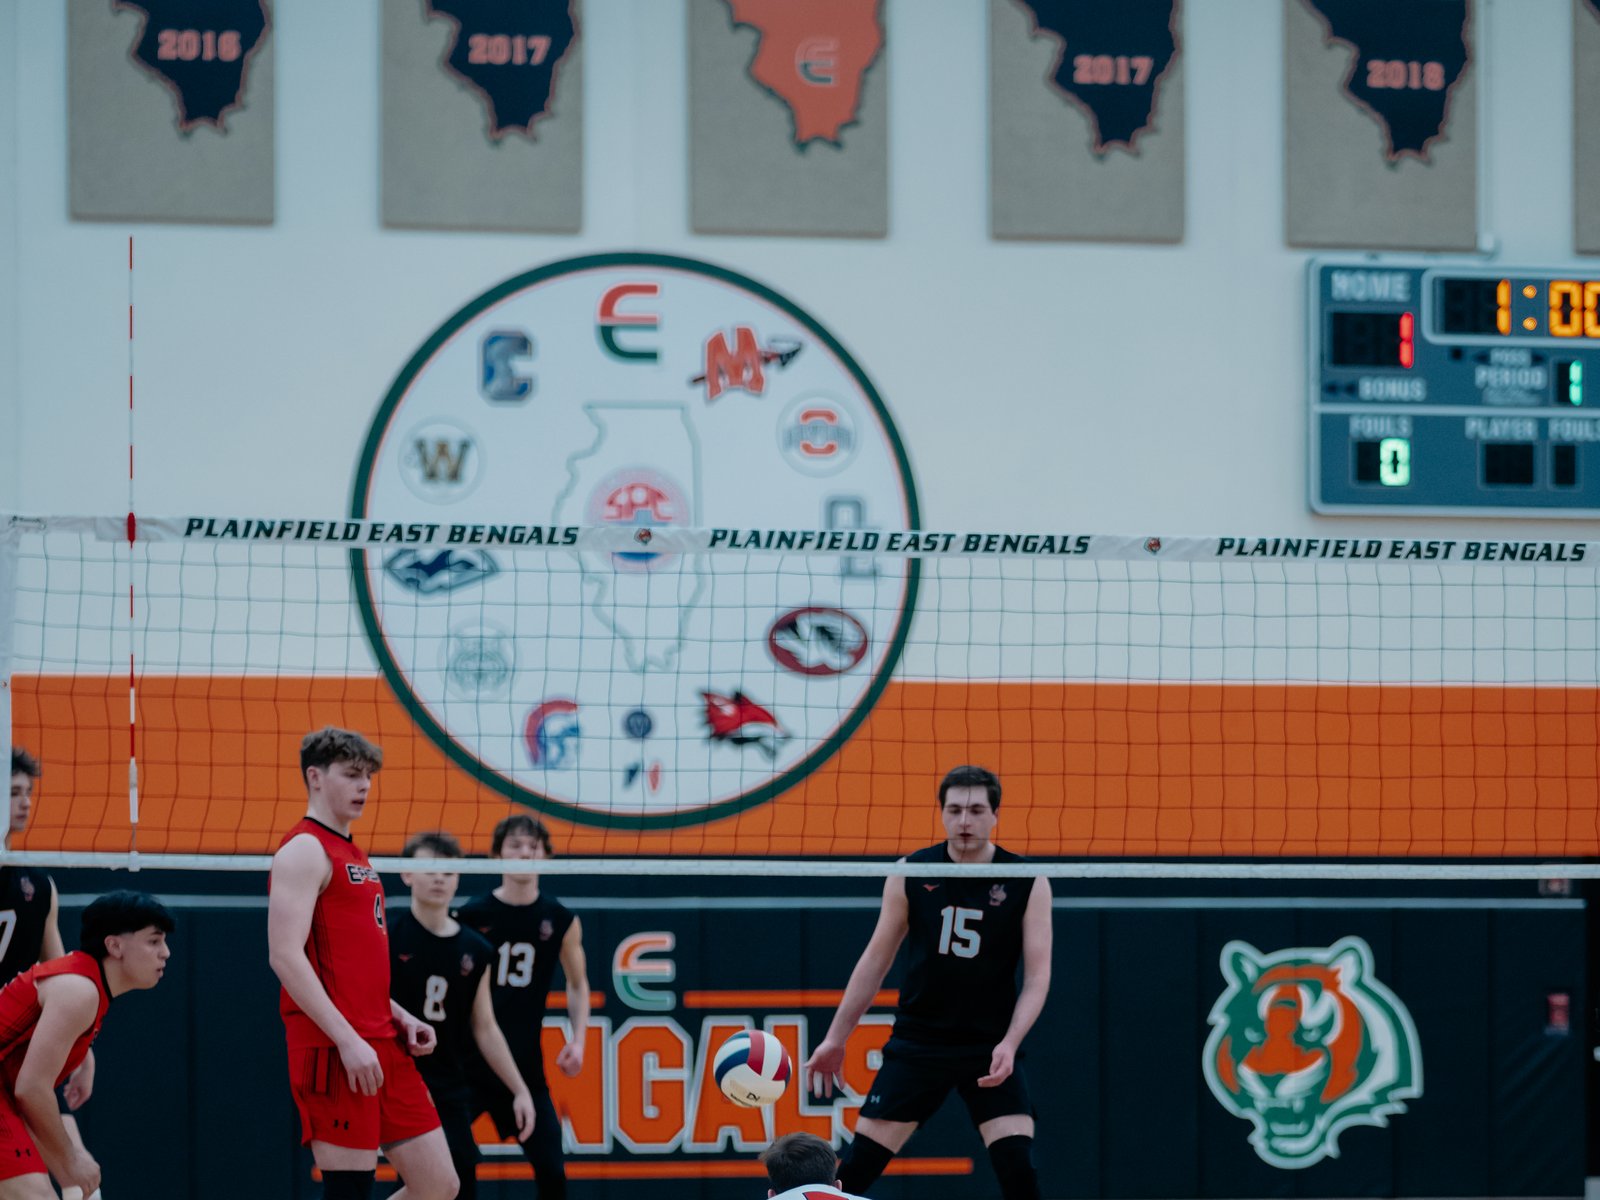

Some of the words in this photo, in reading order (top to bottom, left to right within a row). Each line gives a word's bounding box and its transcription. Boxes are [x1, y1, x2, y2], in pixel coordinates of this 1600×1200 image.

[468, 34, 550, 66] 2017
[1073, 55, 1153, 86] 2017
[1366, 59, 1445, 91] 2018
[1331, 271, 1412, 302] HOME
[598, 283, 660, 362] E
[1400, 312, 1414, 369] 1
[480, 330, 534, 405] C
[1475, 367, 1547, 390] PERIOD
[1569, 360, 1583, 406] 1
[1359, 377, 1427, 401] BONUS
[1350, 416, 1413, 439] FOULS
[1465, 418, 1538, 440] PLAYER
[414, 439, 470, 483] W
[1380, 437, 1411, 487] 0
[185, 518, 359, 541] PLAINFIELD
[367, 524, 440, 543] EAST
[447, 525, 580, 545] BENGALS
[708, 529, 880, 551] PLAINFIELD
[885, 532, 956, 552] EAST
[962, 534, 1091, 554] BENGALS
[1216, 537, 1382, 559] PLAINFIELD
[1388, 540, 1457, 560] EAST
[1461, 541, 1587, 562] BENGALS
[938, 905, 984, 959] 15
[497, 941, 536, 988] 13
[612, 931, 677, 1012] E
[423, 974, 448, 1022] 8
[470, 1014, 896, 1155] NGALS
